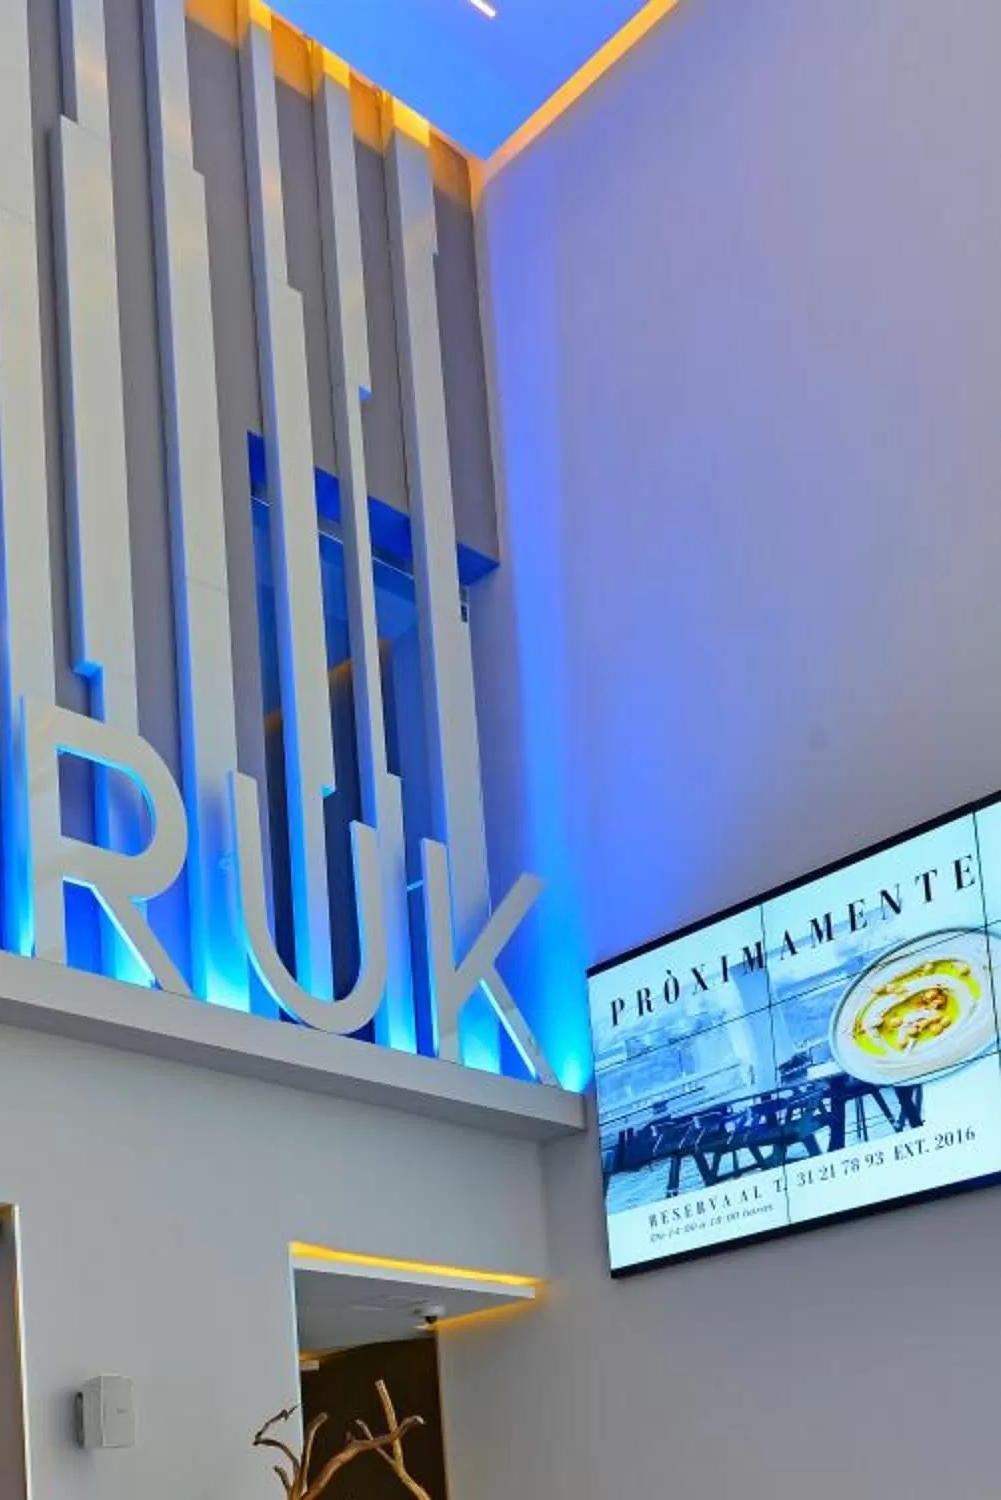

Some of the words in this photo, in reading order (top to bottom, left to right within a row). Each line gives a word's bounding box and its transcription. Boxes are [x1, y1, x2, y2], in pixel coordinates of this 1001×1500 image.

[649, 1194, 731, 1228] RESERVA
[741, 1185, 762, 1202] AL
[796, 1169, 813, 1187] 31
[818, 1163, 836, 1181] 21
[841, 1157, 860, 1176] 78
[864, 1150, 885, 1168] 93
[894, 1138, 930, 1161] EXT.
[934, 1126, 976, 1149] 2016
